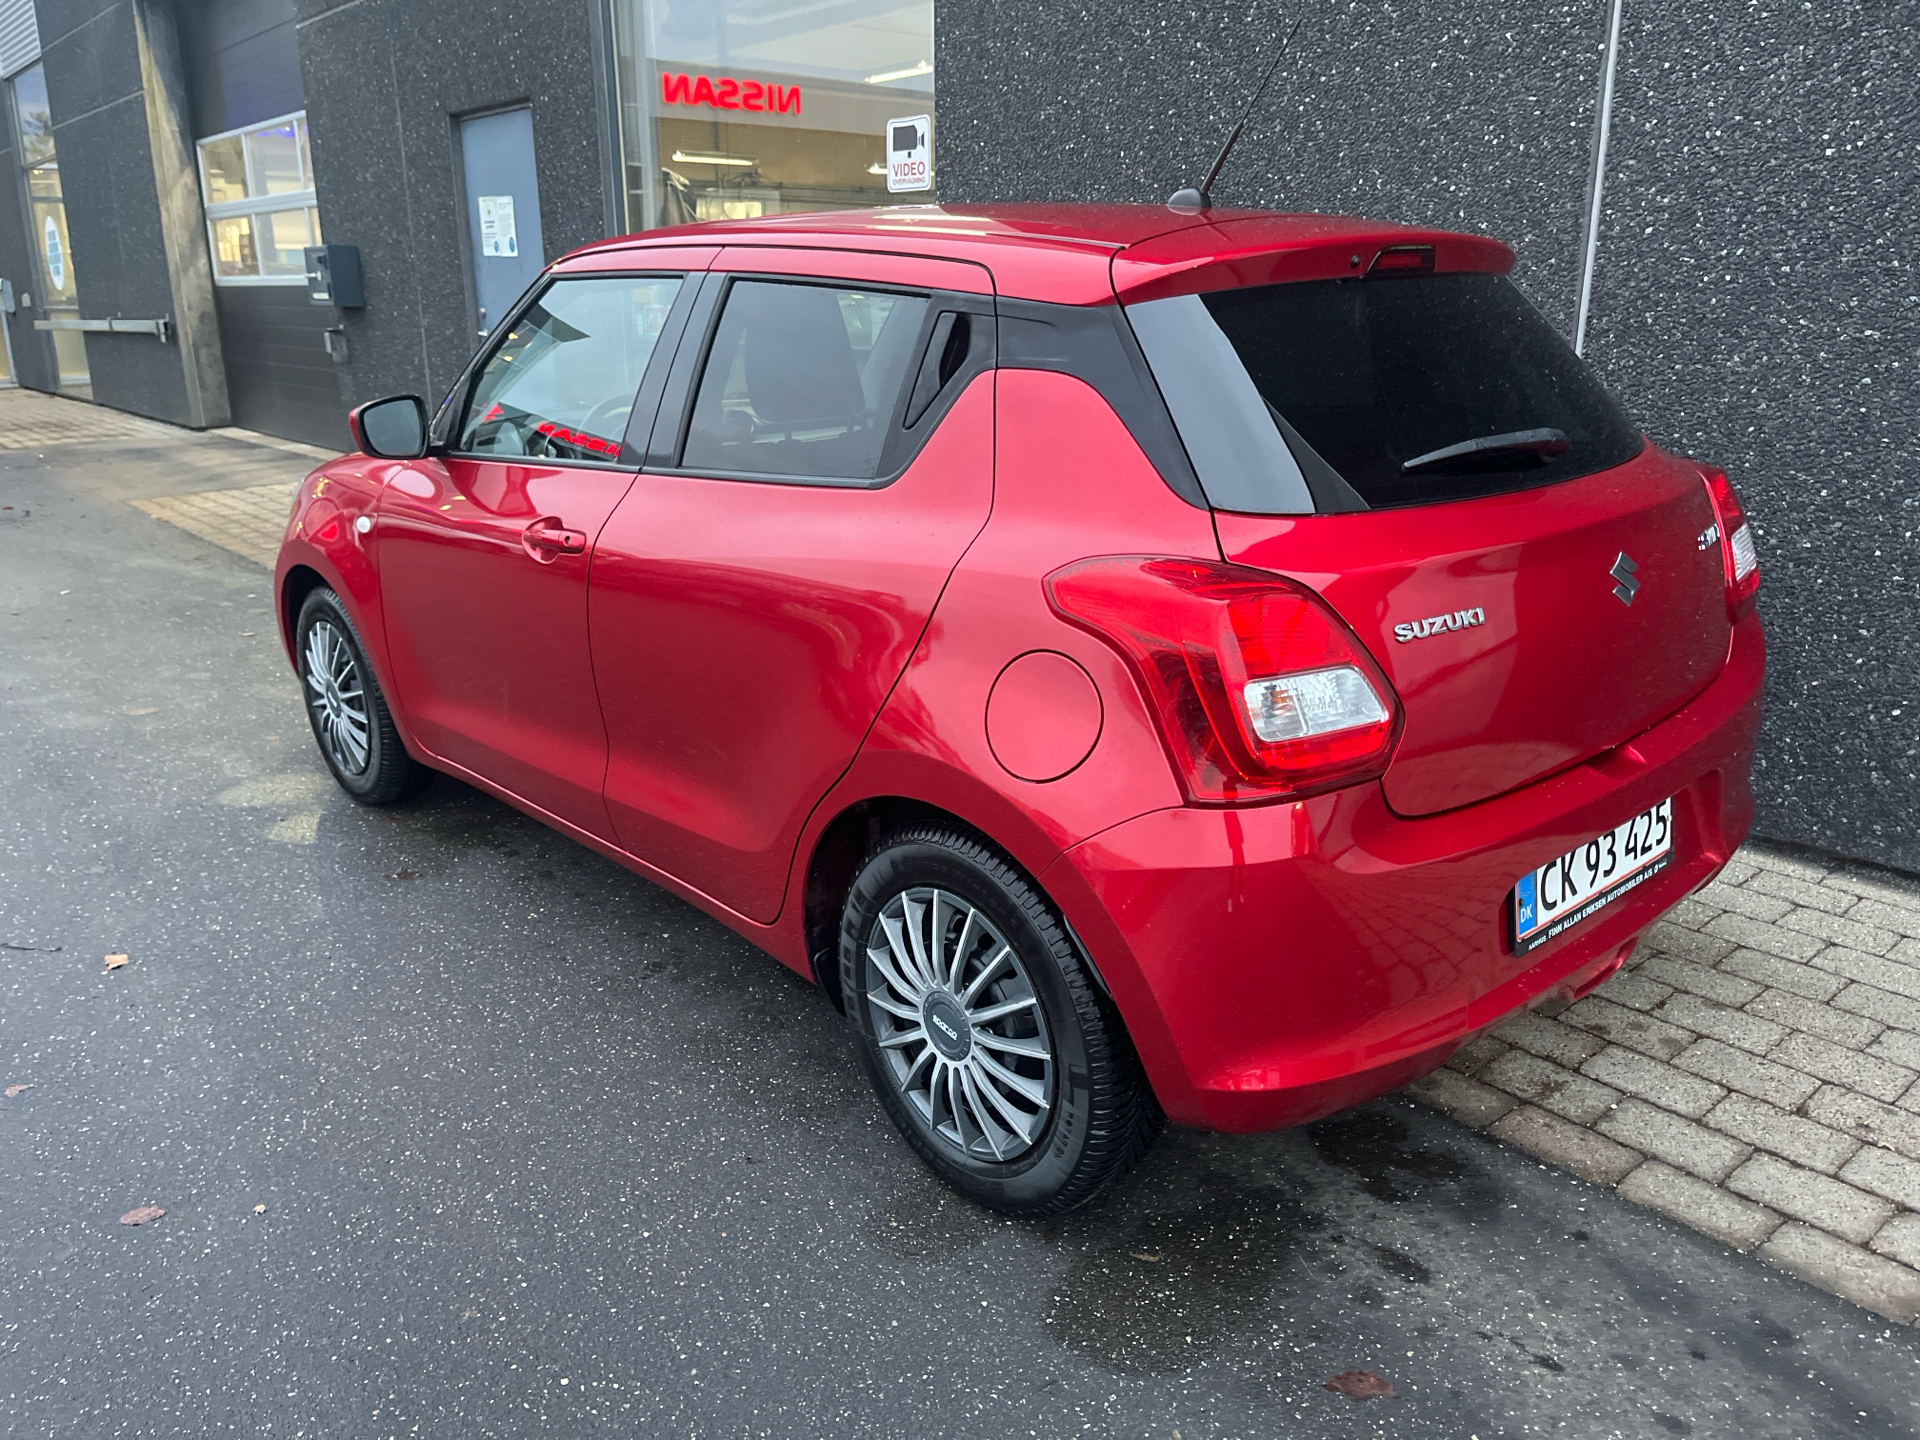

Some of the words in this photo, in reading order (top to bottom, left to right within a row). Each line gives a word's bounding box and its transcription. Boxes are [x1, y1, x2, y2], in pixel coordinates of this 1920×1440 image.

[893, 161, 925, 177] VIDEO
[1394, 607, 1485, 643] SUZUKI
[1540, 849, 1578, 911] CK
[1586, 829, 1617, 889] 93
[1624, 799, 1668, 860] 425
[1520, 904, 1533, 923] DK
[1548, 923, 1562, 939] FINN
[1563, 911, 1582, 930] ALLAN
[1582, 896, 1607, 918] ERIKSEN
[1607, 873, 1644, 903] AUTOMOBILER
